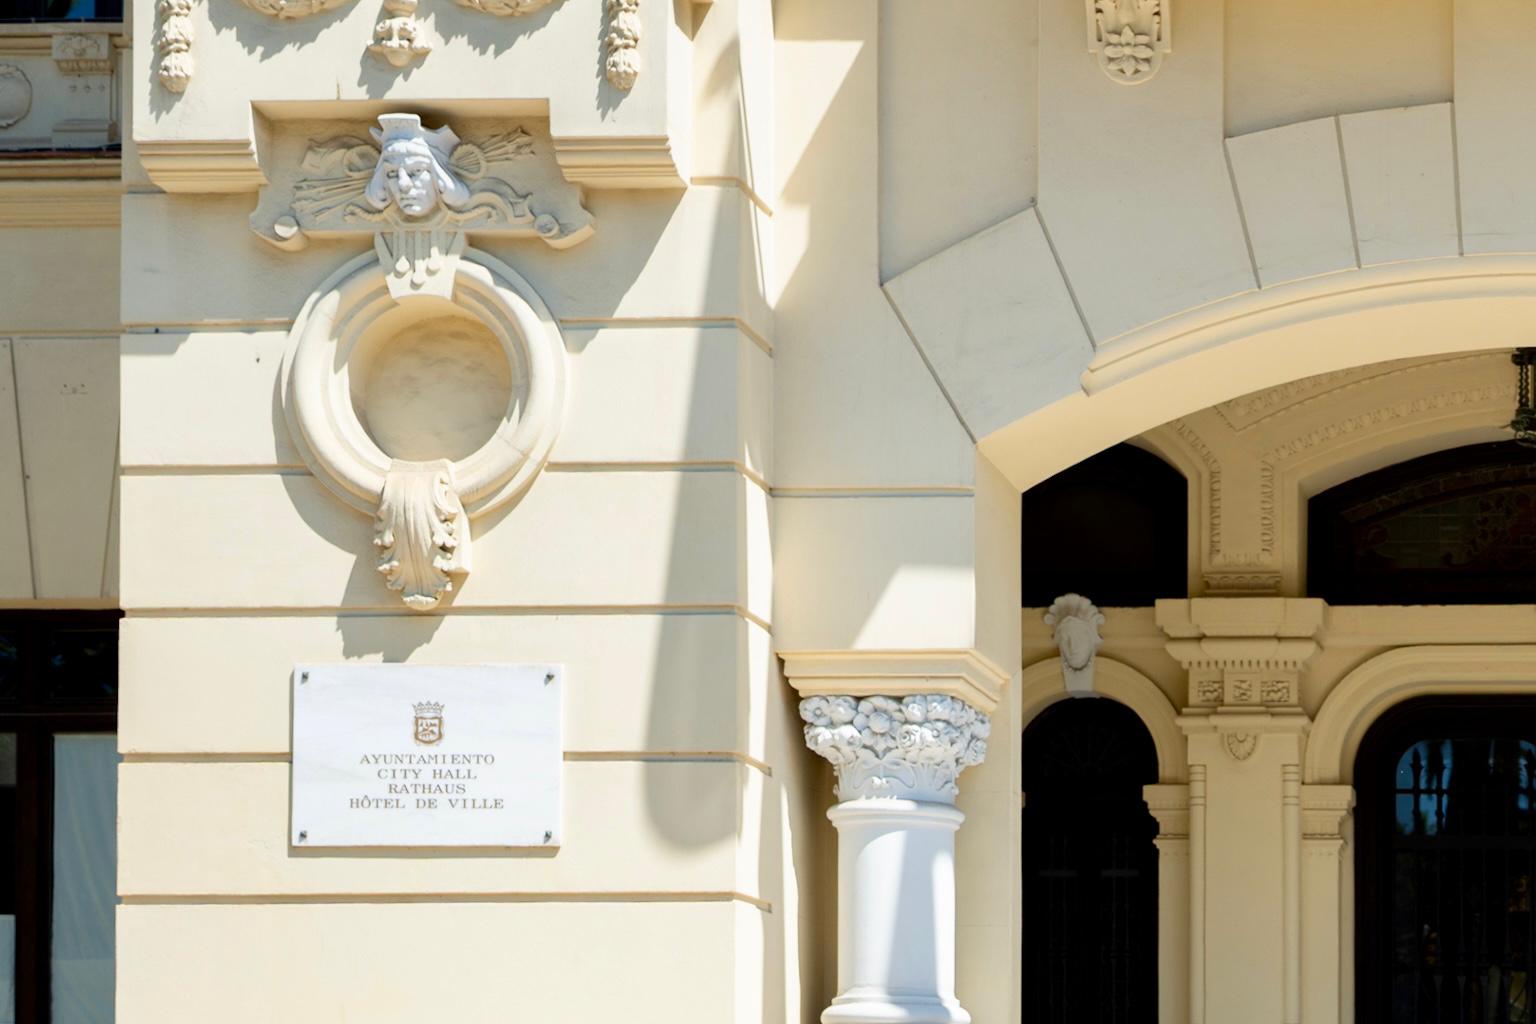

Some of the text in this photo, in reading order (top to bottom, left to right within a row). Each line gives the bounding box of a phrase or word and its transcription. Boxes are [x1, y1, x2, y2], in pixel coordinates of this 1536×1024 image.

[360, 754, 495, 765] AYUNTAMIENTO
[377, 769, 477, 779] CITY HALL
[388, 784, 466, 794] RATHAUS
[350, 796, 504, 809] HÔTEL DE VILLE
